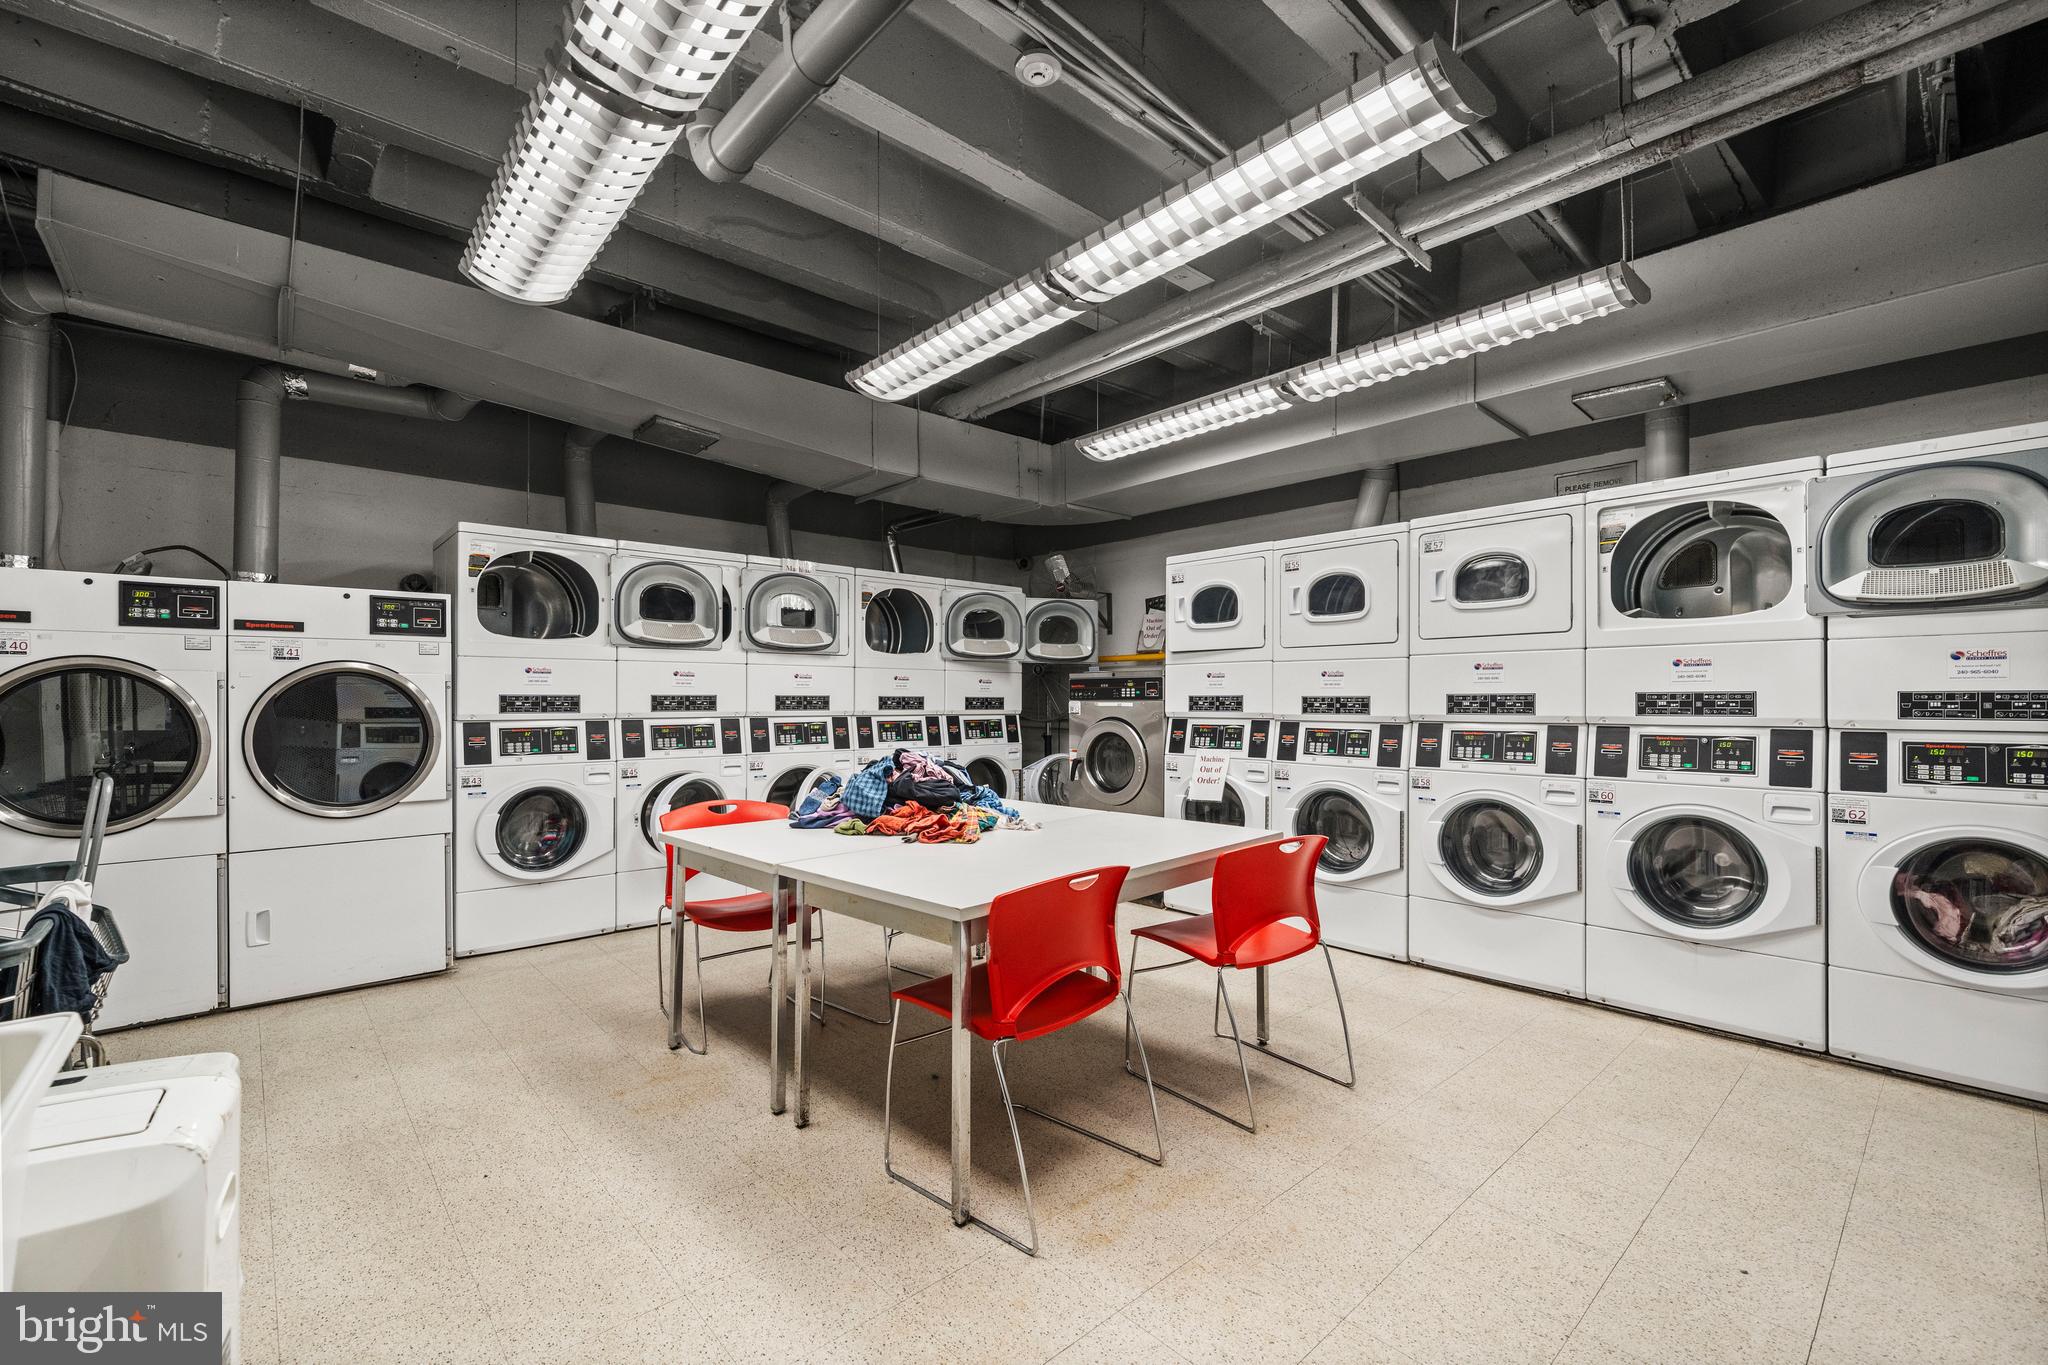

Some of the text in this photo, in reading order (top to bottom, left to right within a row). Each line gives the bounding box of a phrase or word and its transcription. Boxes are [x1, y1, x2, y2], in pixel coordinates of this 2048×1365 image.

[1564, 478, 1624, 492] PLEASE REMOVE
[9, 641, 28, 651] 40
[286, 648, 300, 657] 41
[1966, 649, 2007, 657] Scheffres
[471, 777, 481, 785] 43
[1601, 791, 1614, 800] 60
[1848, 809, 1866, 820] 62
